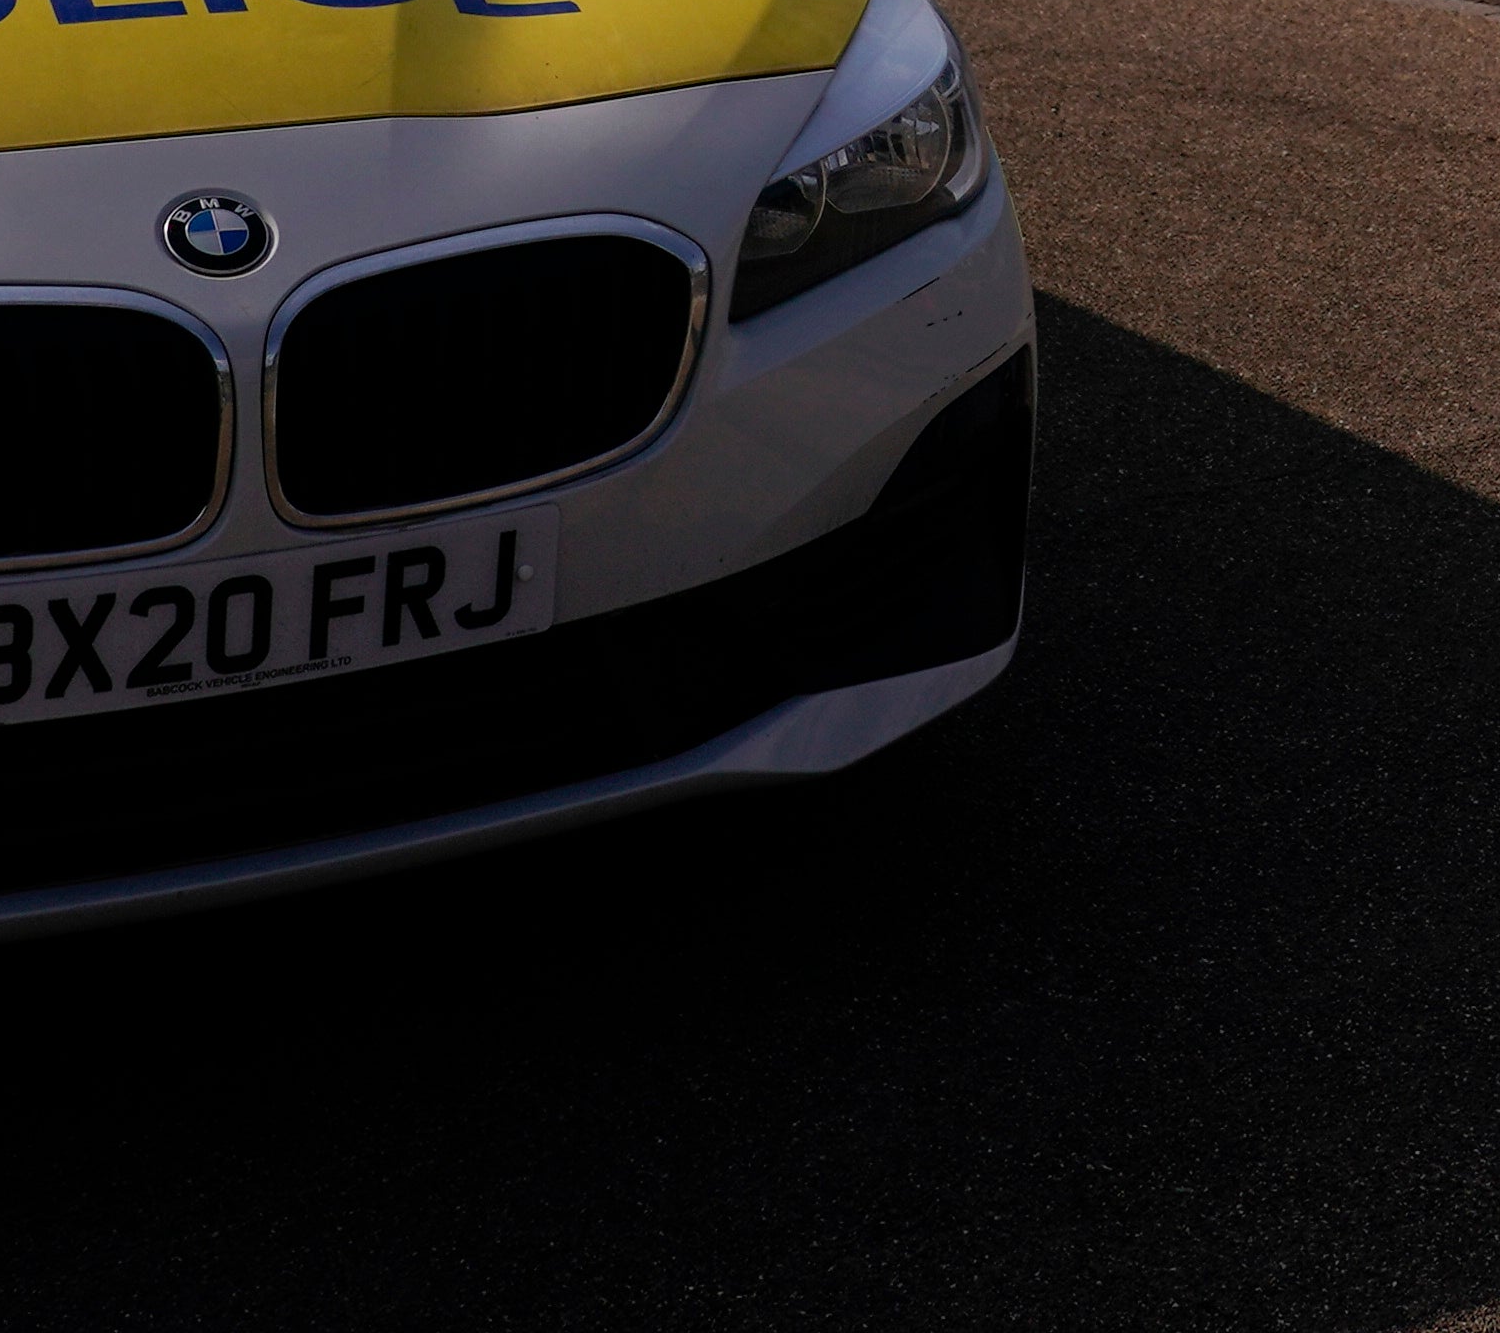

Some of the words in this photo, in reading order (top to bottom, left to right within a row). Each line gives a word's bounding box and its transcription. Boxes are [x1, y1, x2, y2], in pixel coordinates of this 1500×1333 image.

[172, 197, 256, 224] BMW
[308, 529, 518, 661] FRJ
[146, 680, 204, 698] BABCOCK
[205, 673, 253, 689] VEHICLE
[255, 660, 329, 682] ENGINEERING
[331, 656, 352, 668] LTD
